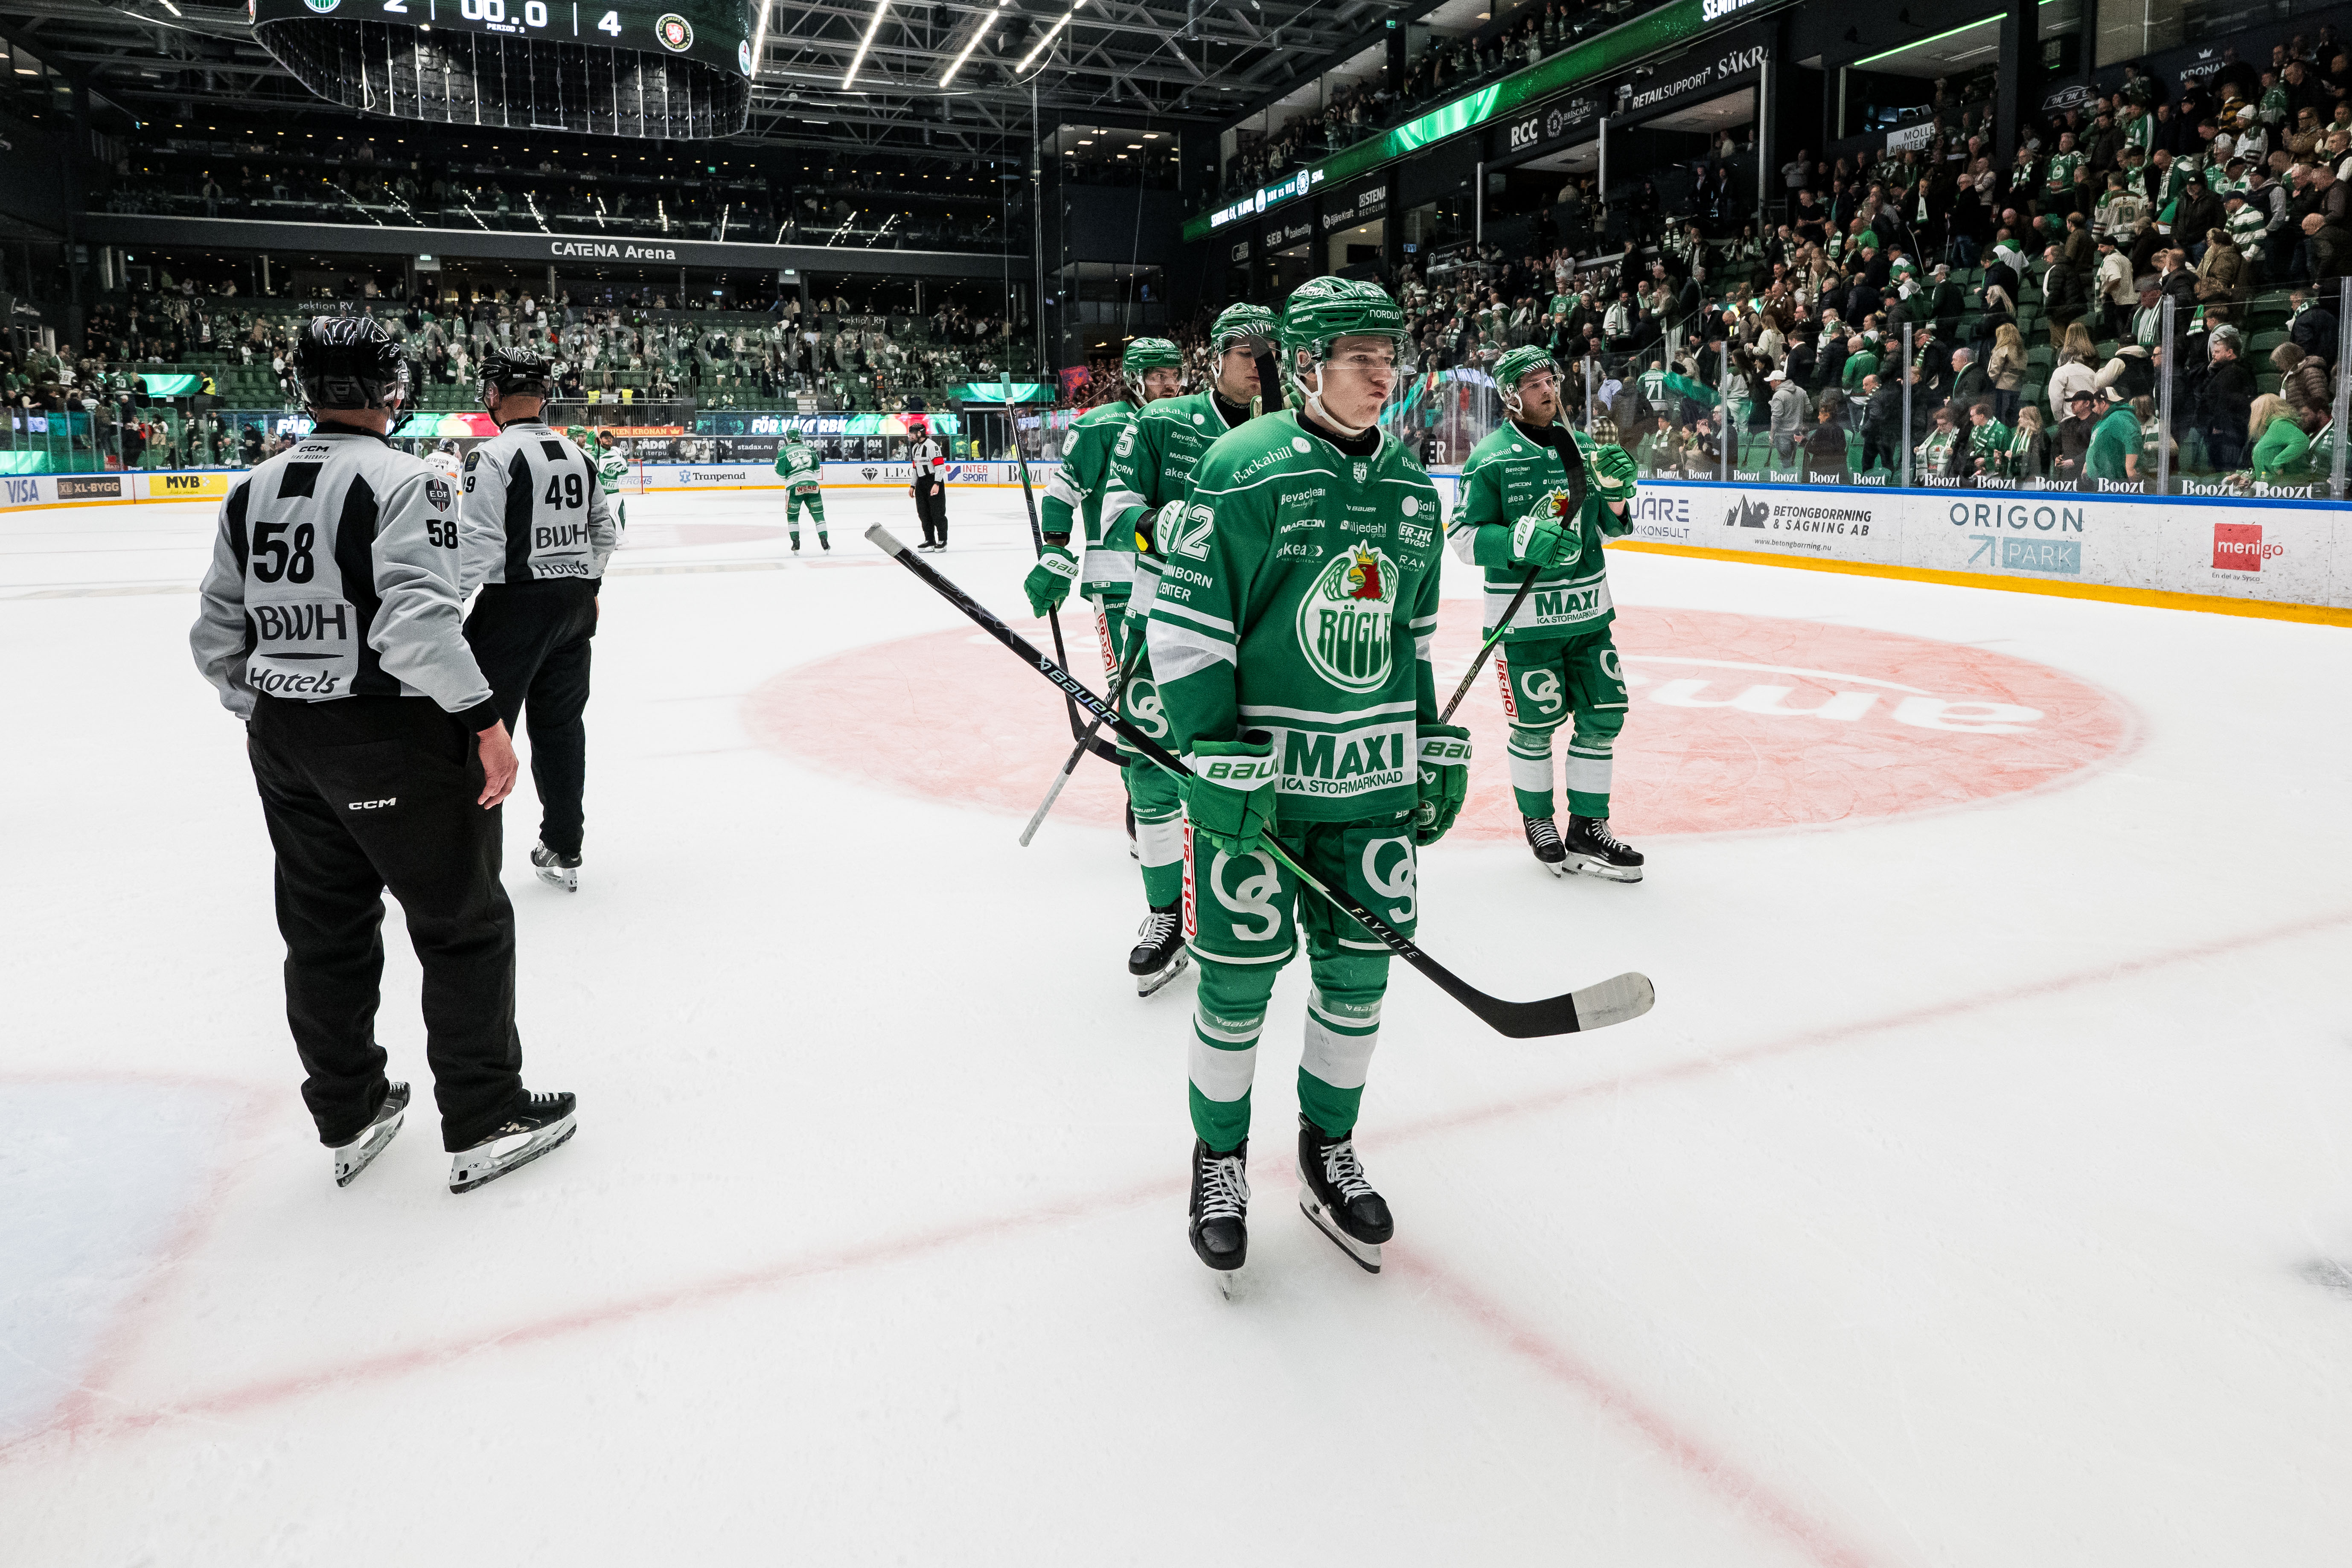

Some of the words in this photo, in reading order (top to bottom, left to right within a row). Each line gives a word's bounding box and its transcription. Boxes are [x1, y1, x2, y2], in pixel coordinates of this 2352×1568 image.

[486, 23, 516, 33] PERIOD
[597, 11, 622, 37] 4
[1718, 46, 1769, 79] SÄKR
[1632, 71, 1708, 110] RETAILSUPPORT
[1511, 118, 1538, 147] RCC
[1904, 125, 1935, 141] MÖLLE
[1365, 186, 1386, 205] STENA
[1330, 214, 1342, 226] Bjäre
[1342, 208, 1354, 220] Kraft
[1359, 202, 1386, 217] RECYCLIN
[1266, 231, 1282, 247] SEB
[1290, 224, 1312, 239] bakertilly
[551, 241, 620, 257] CATENA
[625, 245, 676, 260] Arena
[299, 300, 336, 310] sektion
[340, 302, 354, 310] RV
[1292, 314, 1313, 324] BAUER
[1369, 309, 1400, 320] NORDLO
[1645, 380, 1662, 400] 71
[1094, 412, 1126, 423] Backahill
[1150, 407, 1191, 420] Backahill
[751, 416, 779, 433] FÖR
[819, 419, 848, 433] RBK
[1062, 429, 1079, 457] 8
[1114, 424, 1139, 458] 5
[1481, 448, 1512, 464] Backahill
[963, 465, 988, 473] INTER
[1232, 446, 1293, 485] Backahill
[1353, 468, 1367, 480] 50
[1637, 468, 1649, 479] ozt
[1656, 468, 1680, 479] Boozt
[166, 476, 200, 489] MVB
[693, 472, 746, 482] Tranpenad
[963, 474, 988, 482] SPORT
[1688, 469, 1713, 480] Boozt
[1733, 469, 1760, 483] Boozt
[1770, 470, 1799, 483] Boozt
[1809, 471, 1840, 485] Boozt
[1853, 472, 1886, 486] Boozt
[1924, 474, 1960, 488] Boozt
[1976, 475, 2017, 490] Boozt
[4, 479, 39, 503] VISA
[74, 482, 119, 493] XL-BYGG
[544, 473, 583, 511] 49
[2035, 476, 2078, 492] Boozt
[2097, 477, 2145, 495] Boozt
[2181, 480, 2235, 497] Boozt
[2254, 481, 2313, 500] Boozt
[1418, 500, 1435, 512] Soli
[1508, 495, 1524, 503] akea
[1631, 492, 1689, 523] JÄRE
[1774, 505, 1872, 523] BETONGBORRNING
[1950, 503, 2083, 533] ORIGON
[426, 519, 459, 550] 58
[1170, 503, 1215, 561] 2
[1280, 519, 1325, 534] MARCON
[1633, 525, 1690, 538] KKONSULT
[1773, 519, 1780, 529] &
[1786, 518, 1845, 534] SÅGNING
[1851, 525, 1869, 535] AB
[536, 523, 588, 550] BWH
[1754, 538, 1832, 552] www.betongborrning.nu
[252, 521, 315, 584] 58
[1276, 542, 1307, 558] akea
[2009, 543, 2071, 567] PARK
[2218, 539, 2284, 560] menigo
[534, 560, 589, 576] Hotels
[1159, 582, 1191, 602] CENTER
[1534, 589, 1599, 617] MAXI
[253, 604, 347, 640] BWH
[1319, 604, 1391, 644] RÖGLE
[1537, 617, 1550, 625] ICA
[1551, 608, 1598, 623] STORMARKNAD
[249, 667, 341, 694] Hotels
[1496, 661, 1514, 715] ER-HO
[1048, 669, 1121, 724] BAUER
[1282, 730, 1404, 780] MAXI
[1421, 741, 1472, 760] BAU
[1206, 761, 1279, 780] BAU
[1281, 777, 1306, 791] ICA
[1309, 770, 1403, 794] STORMARKNAD
[349, 797, 396, 810] CCM
[1351, 907, 1420, 959] FLYLITE
